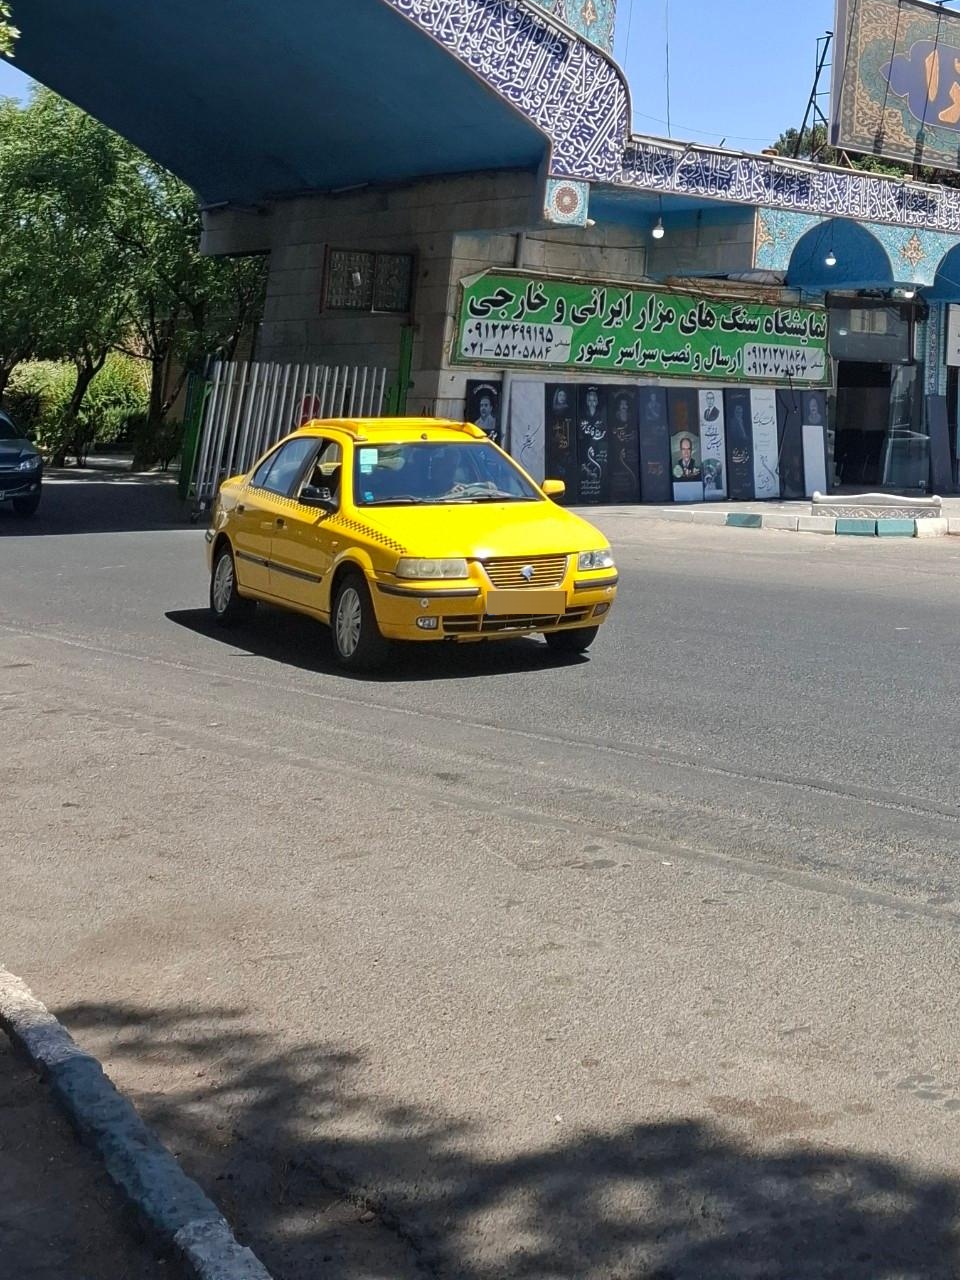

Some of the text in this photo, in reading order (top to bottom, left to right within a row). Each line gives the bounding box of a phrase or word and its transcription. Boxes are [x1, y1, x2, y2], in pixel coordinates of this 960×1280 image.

[468, 280, 828, 344] نمایشگاه سنگ های مزار ایرانی و خارجی
[467, 321, 555, 344] ۰۹۱۲۳۴۹۹۱۹۵
[574, 334, 742, 375] ارسال و نصب سراسر کشور
[747, 345, 807, 364] ۰۹۱۲۱۲۷۱۸۶۸
